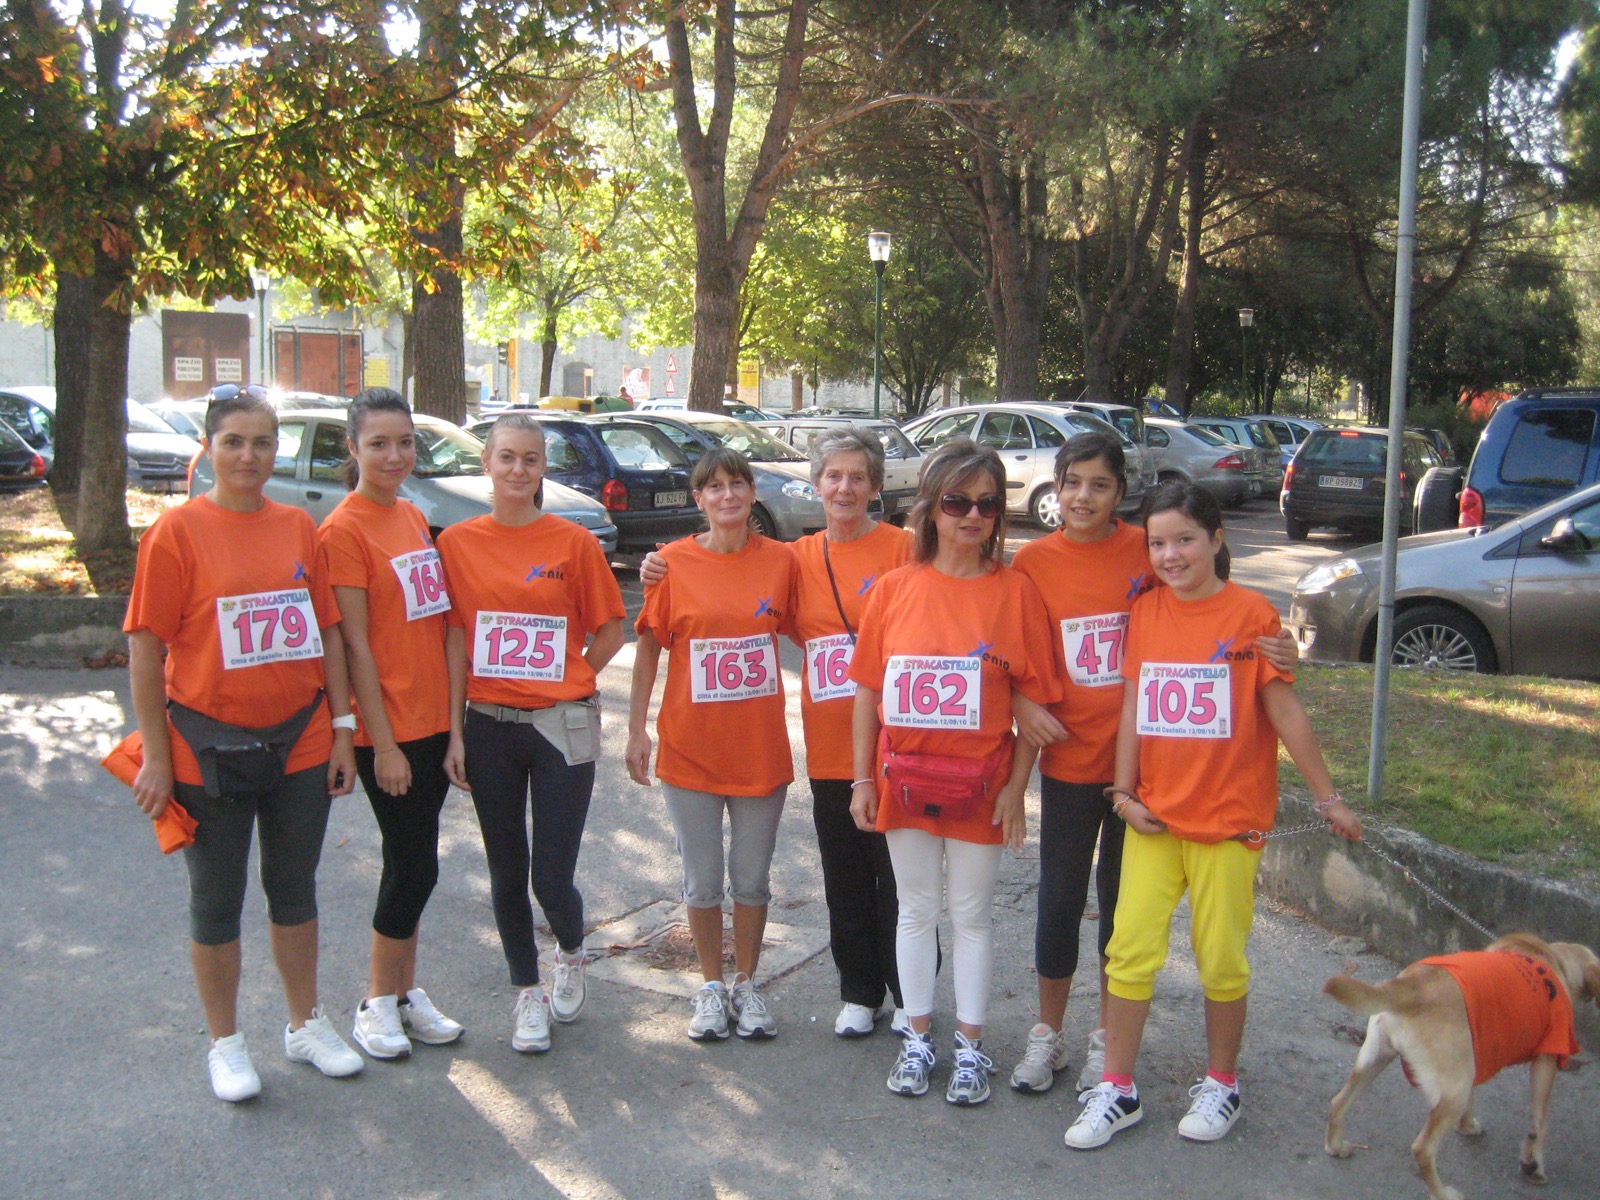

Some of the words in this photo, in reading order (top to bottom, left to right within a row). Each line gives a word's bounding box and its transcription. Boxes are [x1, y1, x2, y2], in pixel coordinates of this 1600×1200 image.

[239, 591, 309, 610] STRACASTELLO
[496, 615, 566, 630] STRACASTELLO
[233, 605, 308, 655] 179
[485, 626, 555, 669] 125
[709, 635, 772, 651] STRACASTELLO
[820, 636, 856, 650] STRACA
[1209, 636, 1256, 663] Xenia
[230, 656, 248, 666] Città
[248, 655, 256, 663] di
[256, 652, 283, 662] Castello
[903, 659, 980, 671] STRACASTELLO
[478, 667, 493, 675] Città
[501, 668, 526, 677] Castello
[527, 670, 552, 678] 12/09/10
[700, 648, 767, 691] 163
[1153, 667, 1228, 679] STRACASTELLO
[697, 692, 711, 700] Città
[720, 691, 743, 699] Castello
[828, 687, 851, 696] Castello
[894, 671, 968, 716] 162
[1144, 679, 1217, 725] 105
[889, 716, 904, 724] Città
[912, 717, 938, 725] Castello
[939, 718, 967, 726] 12/09/10
[1161, 726, 1187, 734] Castello
[1188, 727, 1216, 735] 12/09/10
